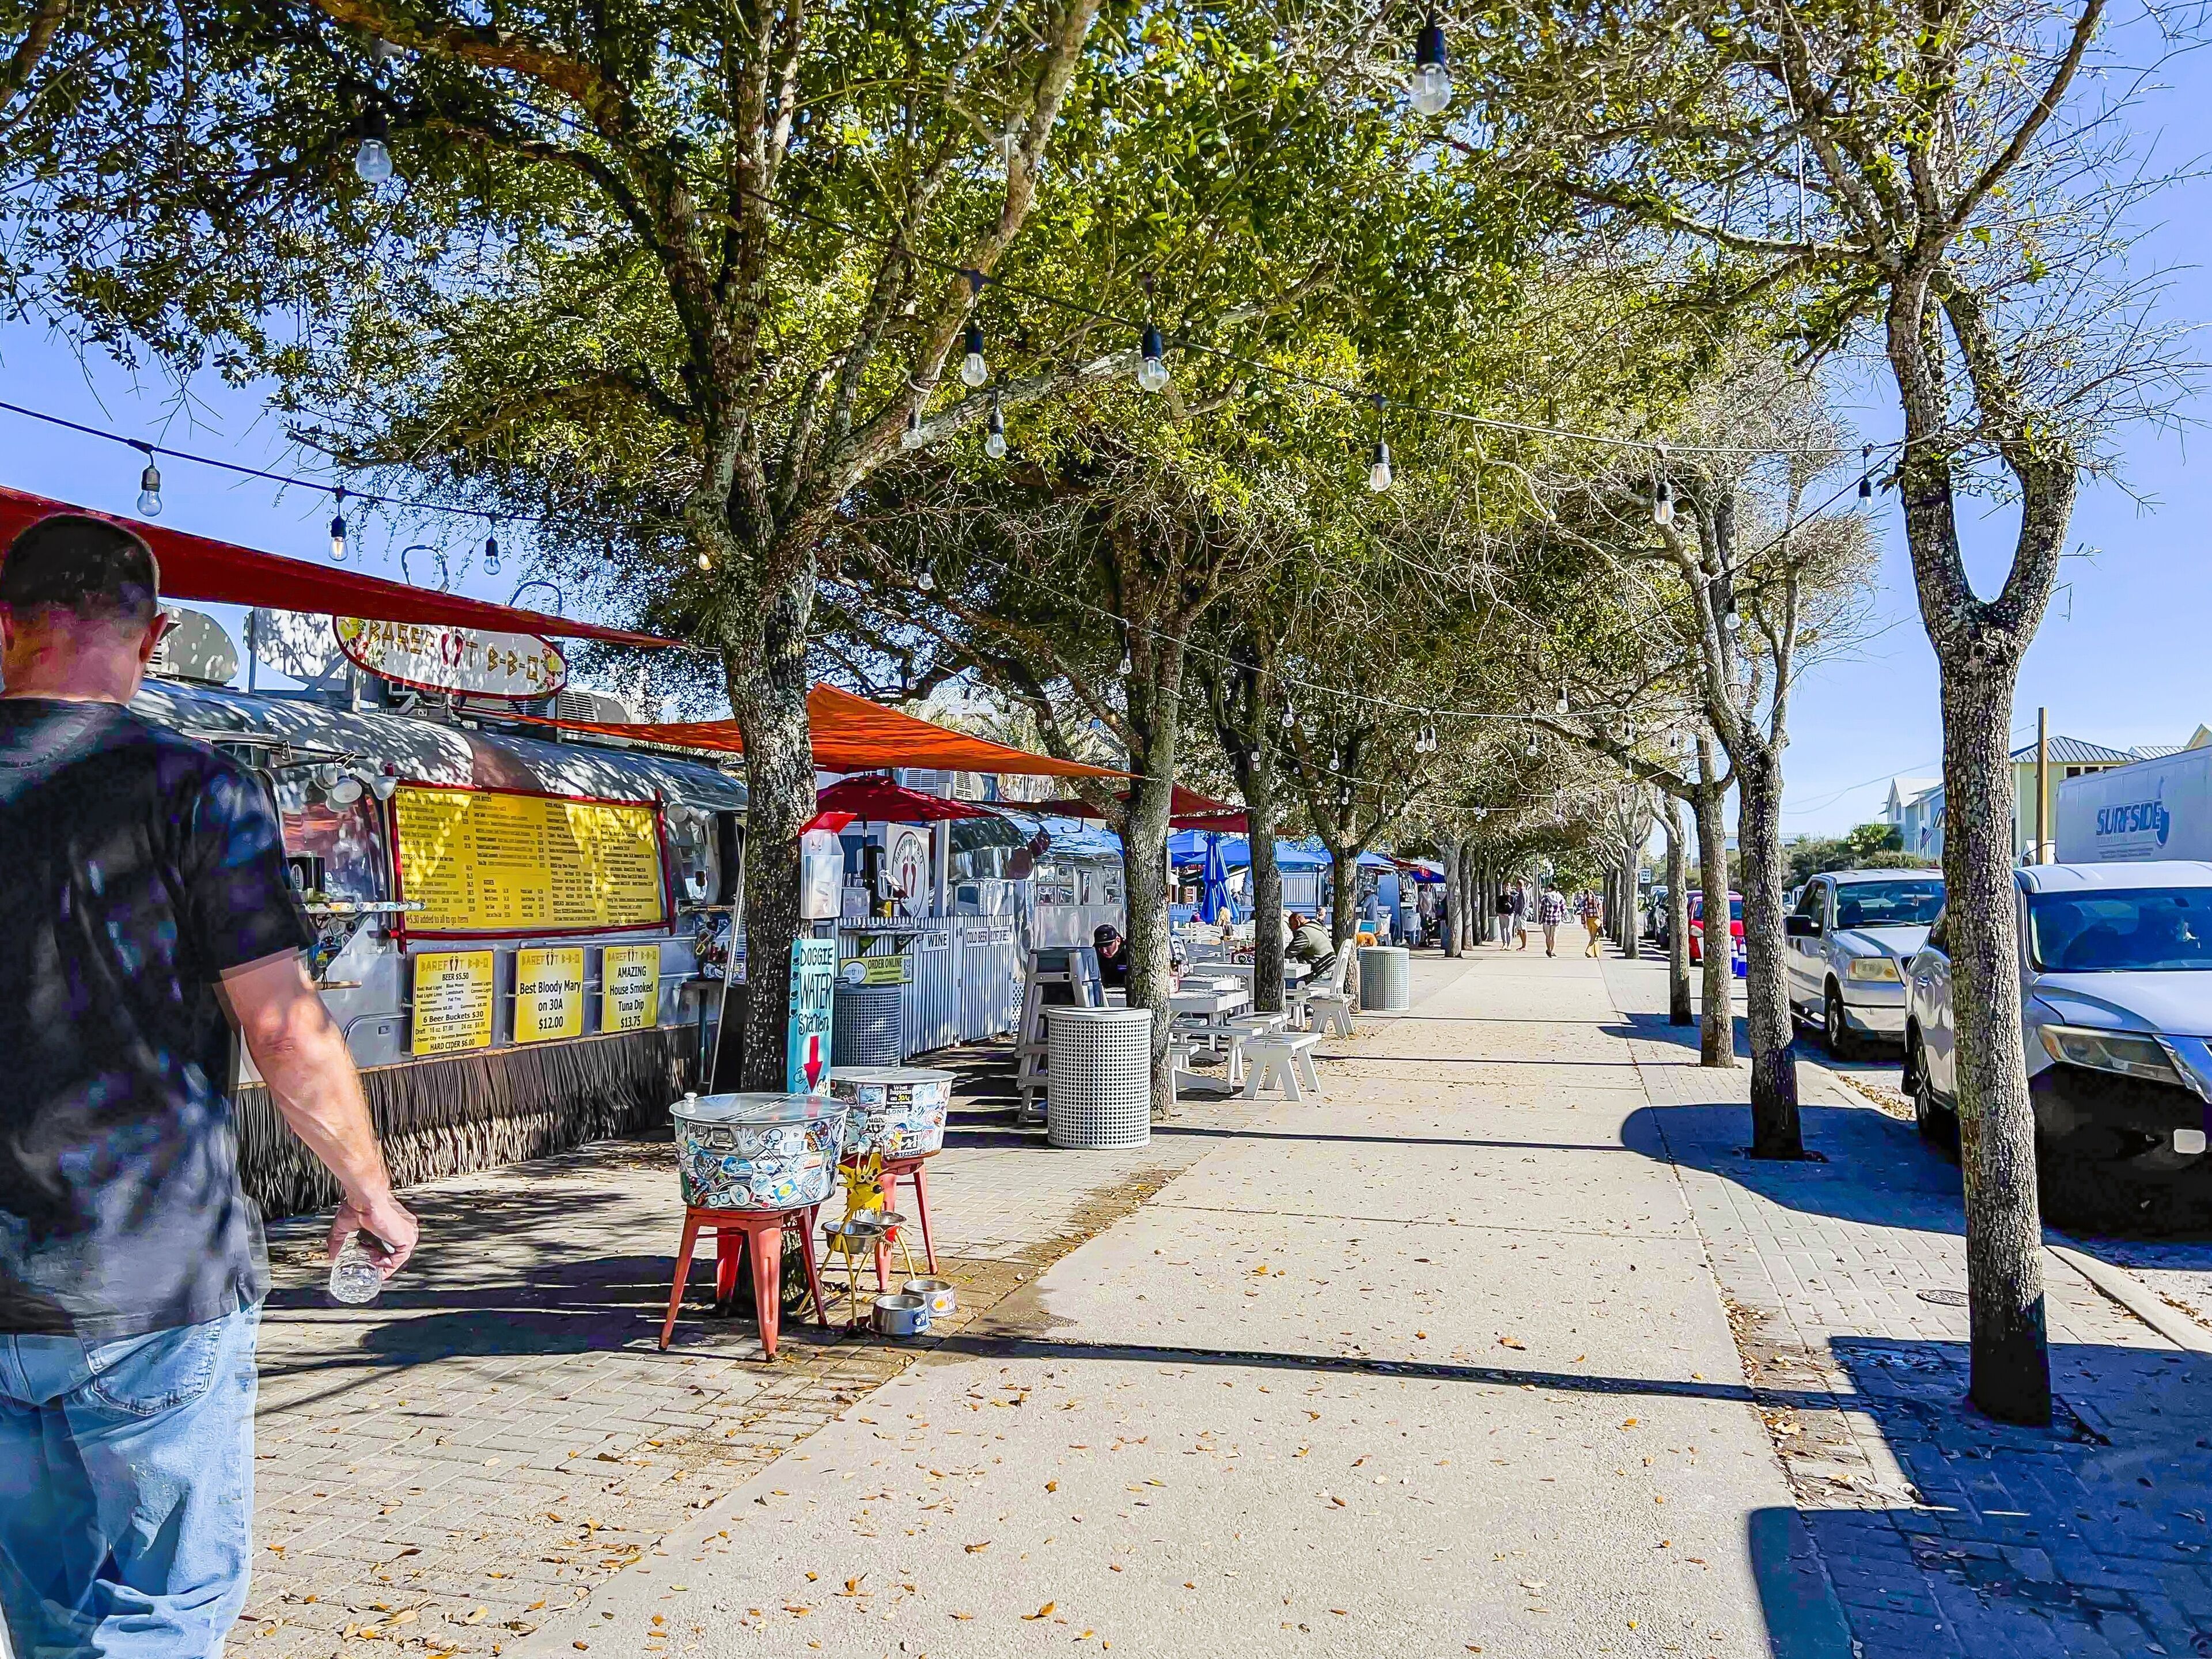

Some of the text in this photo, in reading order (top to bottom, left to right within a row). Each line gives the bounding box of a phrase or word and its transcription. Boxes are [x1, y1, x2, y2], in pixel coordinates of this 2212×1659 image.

[2096, 800, 2162, 835] SURFSIDE
[927, 933, 948, 948] WINE
[967, 931, 978, 944] COLD
[979, 931, 987, 943] BEER
[800, 946, 834, 967] DOGGIE
[868, 957, 902, 969] ORDER ONLINE
[442, 972, 469, 982] BEER $5.50
[618, 966, 646, 978] AMAZING
[520, 980, 581, 995] Best Bloody Mary
[609, 981, 654, 996] House Smoked
[799, 972, 832, 1010] WATER
[538, 999, 563, 1012] on 30A
[618, 998, 645, 1012] Tuna Dip
[429, 1015, 444, 1023] Beer
[445, 1012, 471, 1021] Buckets
[472, 1010, 484, 1019] $30
[538, 1015, 563, 1030] $12.00
[620, 1015, 641, 1029] $13.75
[430, 1038, 475, 1051] HARD CIDER $6.00
